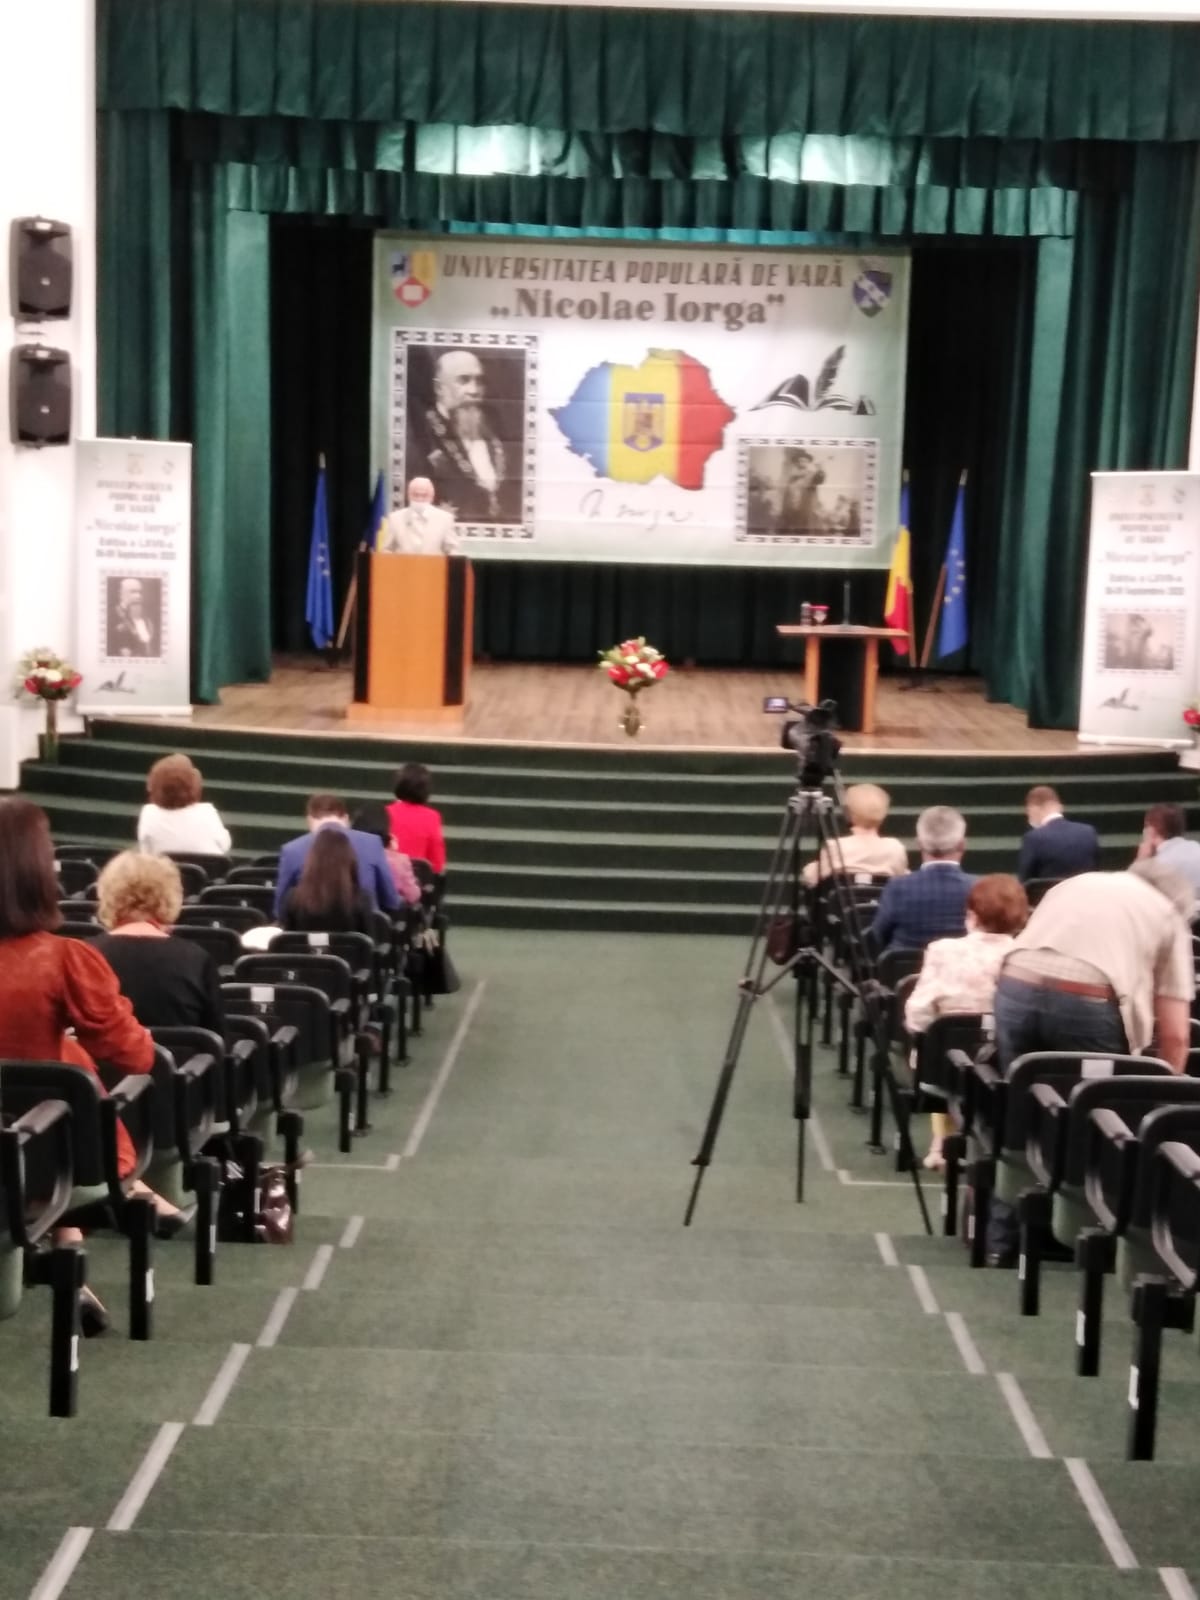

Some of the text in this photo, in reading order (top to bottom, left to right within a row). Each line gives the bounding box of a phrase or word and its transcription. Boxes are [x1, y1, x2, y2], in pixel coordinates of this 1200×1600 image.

[442, 254, 844, 288] UNIVERSITATEA POPULARĂ DE VARĂ
